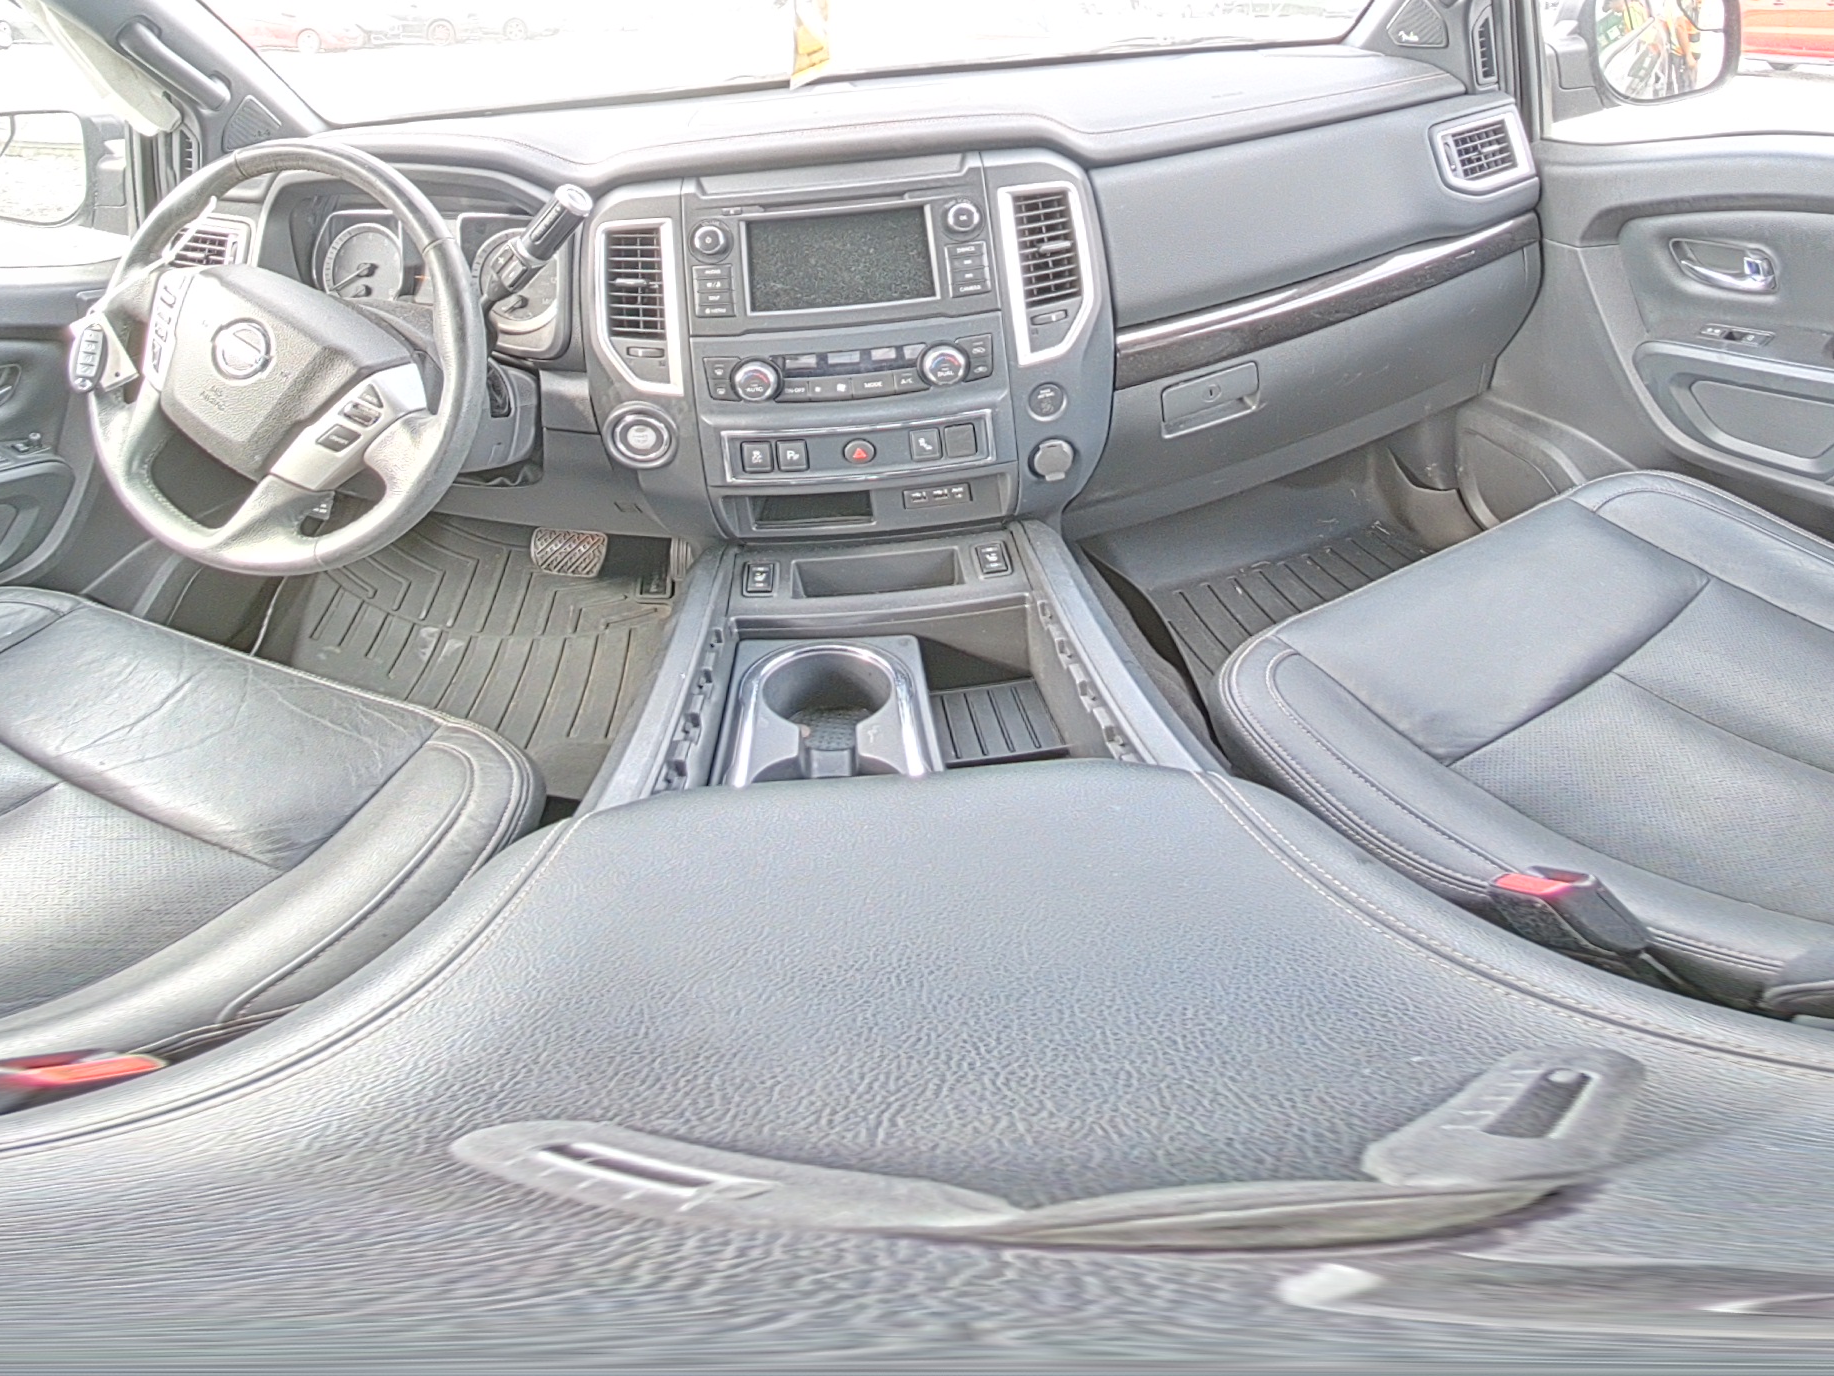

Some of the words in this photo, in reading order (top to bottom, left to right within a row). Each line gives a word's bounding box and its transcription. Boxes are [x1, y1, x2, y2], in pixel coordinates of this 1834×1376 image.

[937, 369, 955, 378] DUAL
[864, 380, 883, 389] MODE
[900, 376, 914, 385] A/C
[744, 385, 764, 393] AUTO
